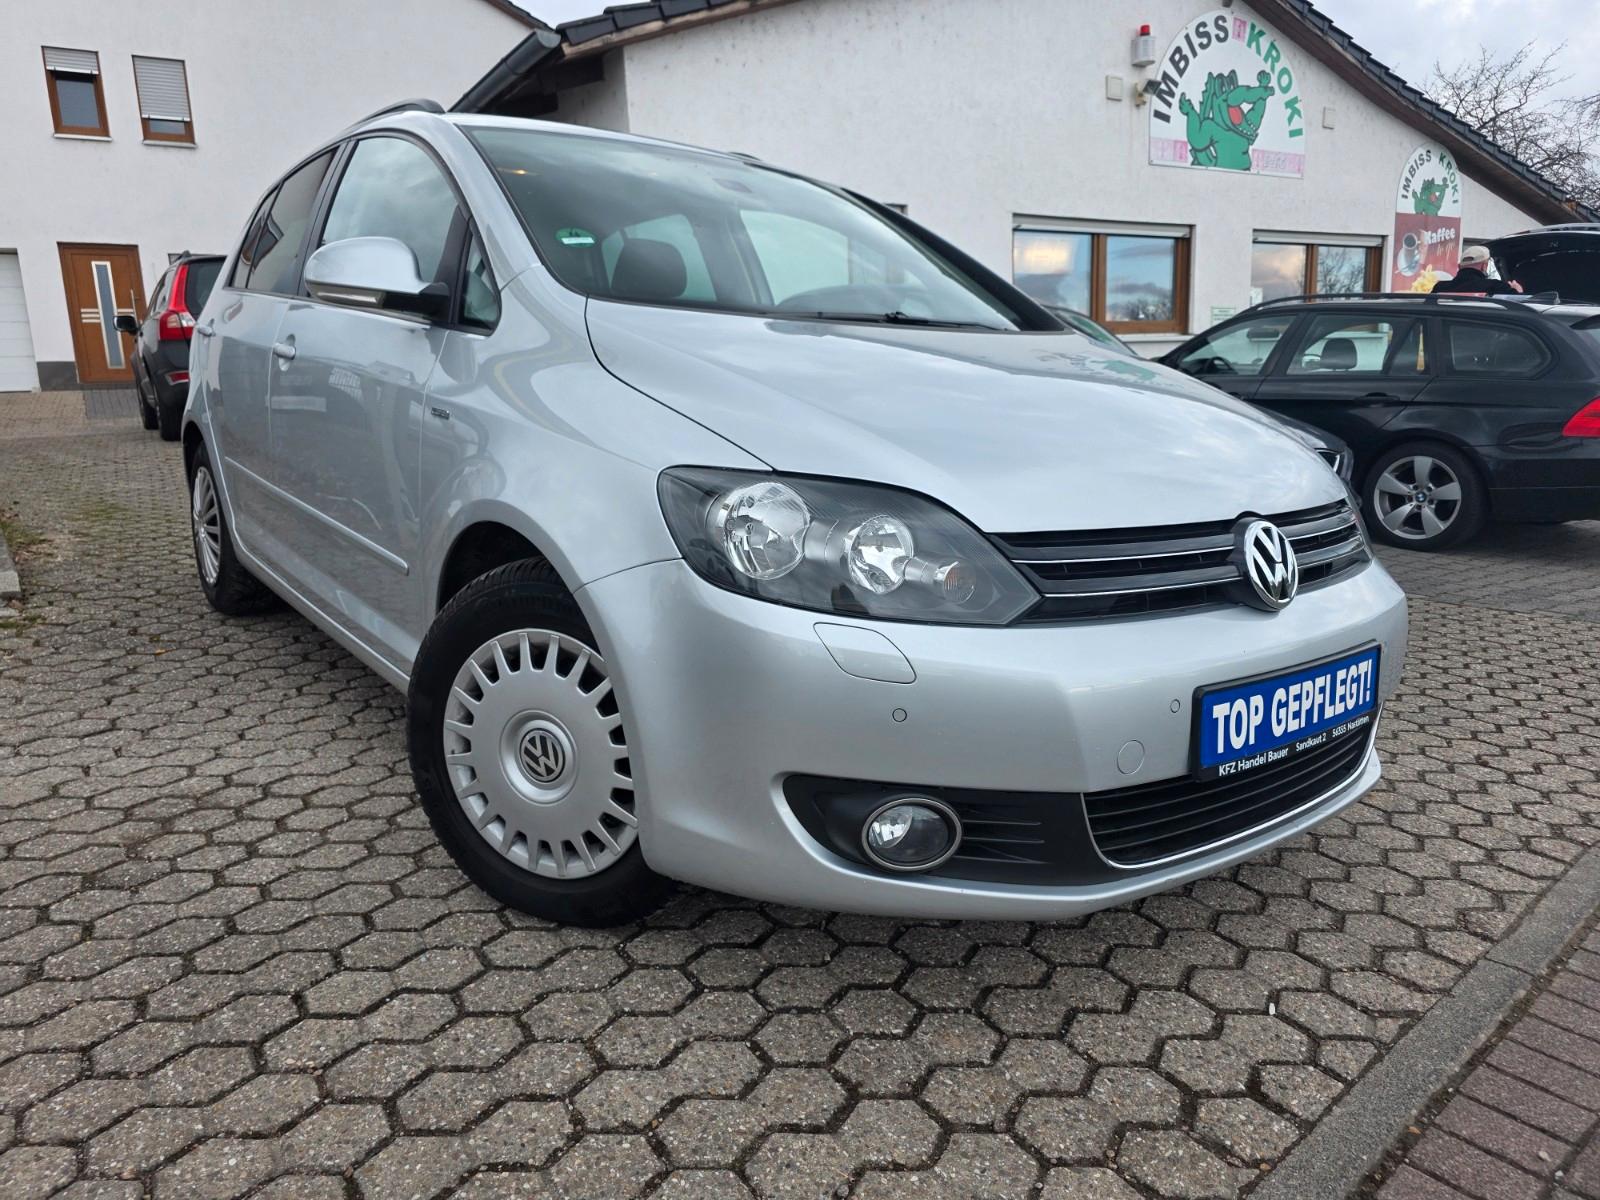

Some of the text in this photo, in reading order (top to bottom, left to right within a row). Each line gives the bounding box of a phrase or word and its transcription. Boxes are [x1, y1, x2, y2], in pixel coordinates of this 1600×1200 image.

[1153, 15, 1304, 138] IMBISS KROKI
[1401, 150, 1459, 204] IMBISS KROKI
[1424, 227, 1456, 245] Kaffee
[1213, 658, 1372, 754] TOP GEPFLEGT!
[1219, 762, 1237, 777] KFZ
[1238, 753, 1267, 772] Handel
[1268, 747, 1289, 762] Bauer
[1322, 732, 1328, 742] 2
